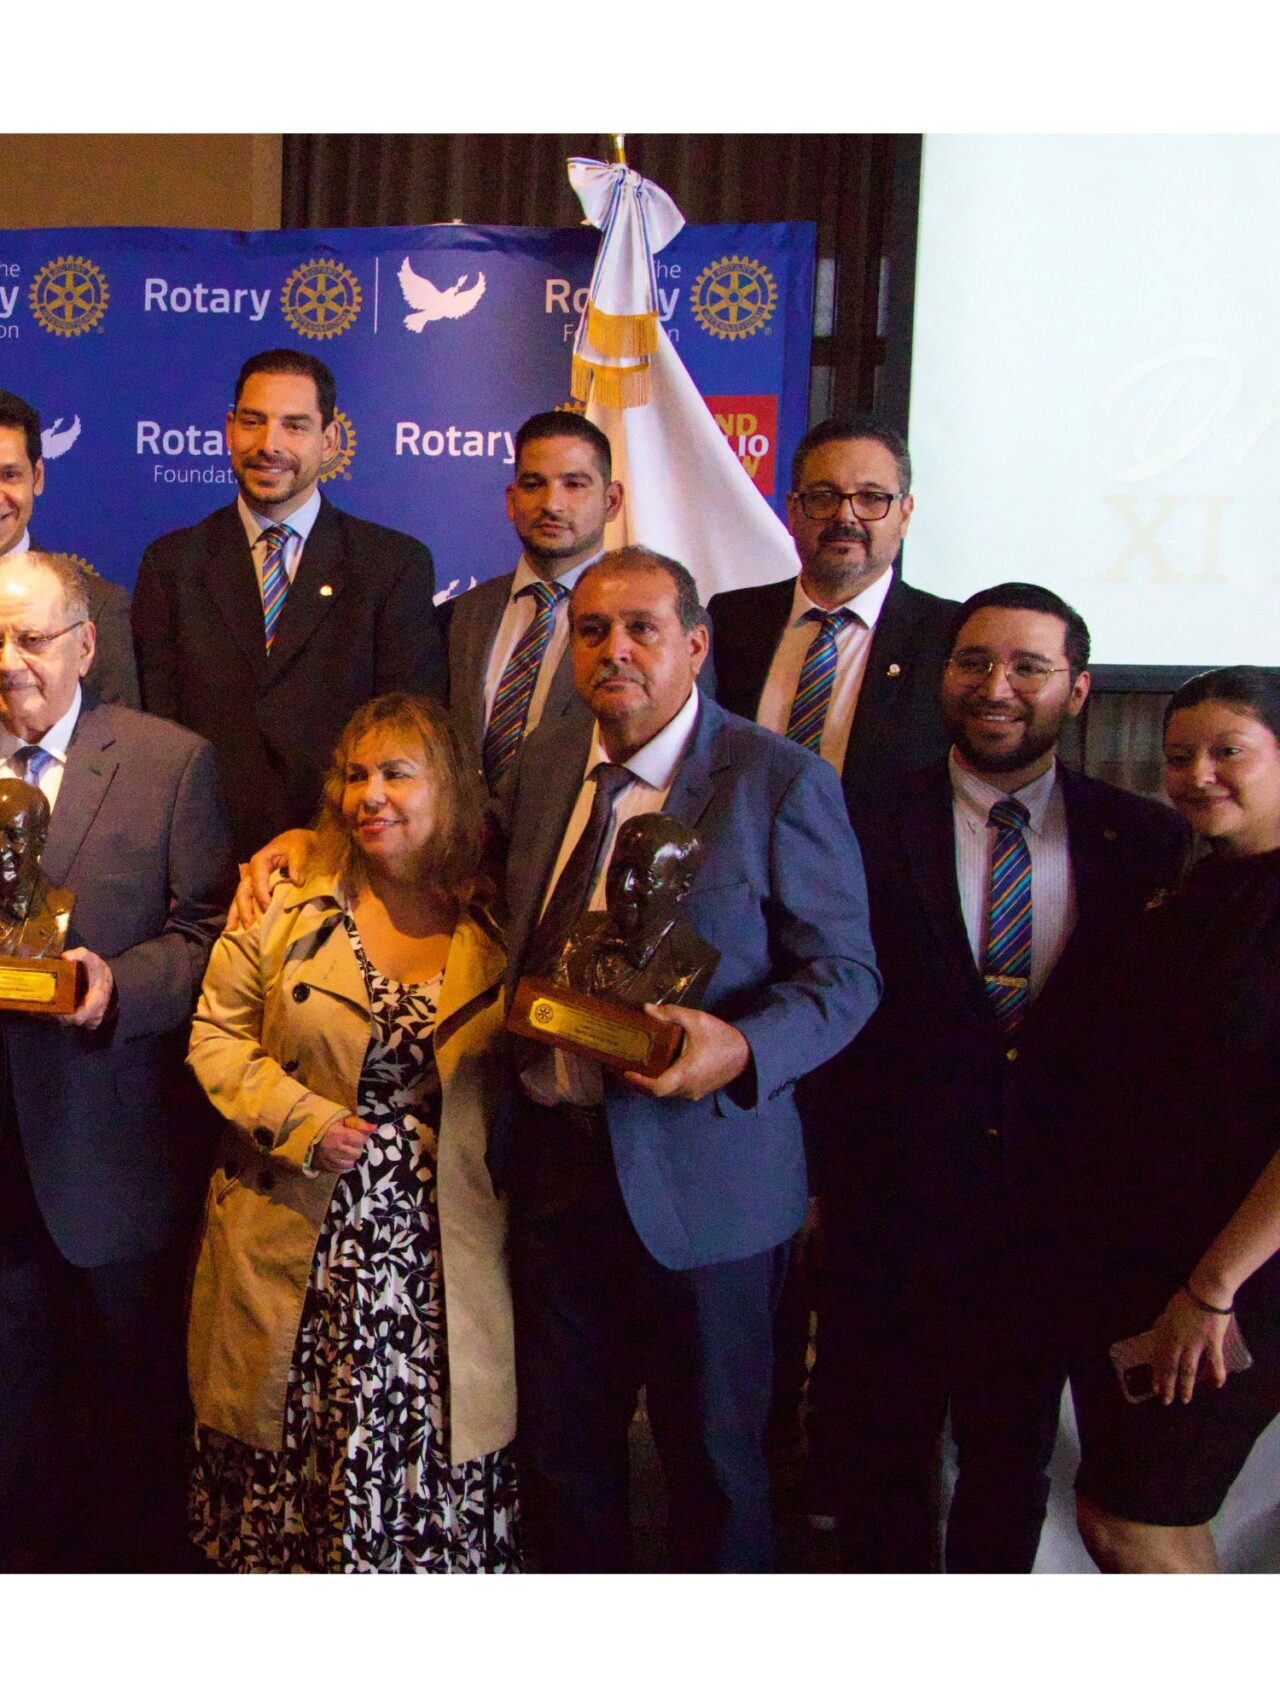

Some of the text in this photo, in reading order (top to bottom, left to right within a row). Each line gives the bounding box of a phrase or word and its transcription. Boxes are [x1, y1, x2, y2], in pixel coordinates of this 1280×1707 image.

[654, 259, 681, 279] he
[144, 278, 271, 321] Rotary
[136, 420, 232, 456] Rota
[395, 421, 516, 464] Rotary
[714, 412, 758, 437] ND
[154, 464, 238, 484] Foundat
[1098, 494, 1234, 585] XI
